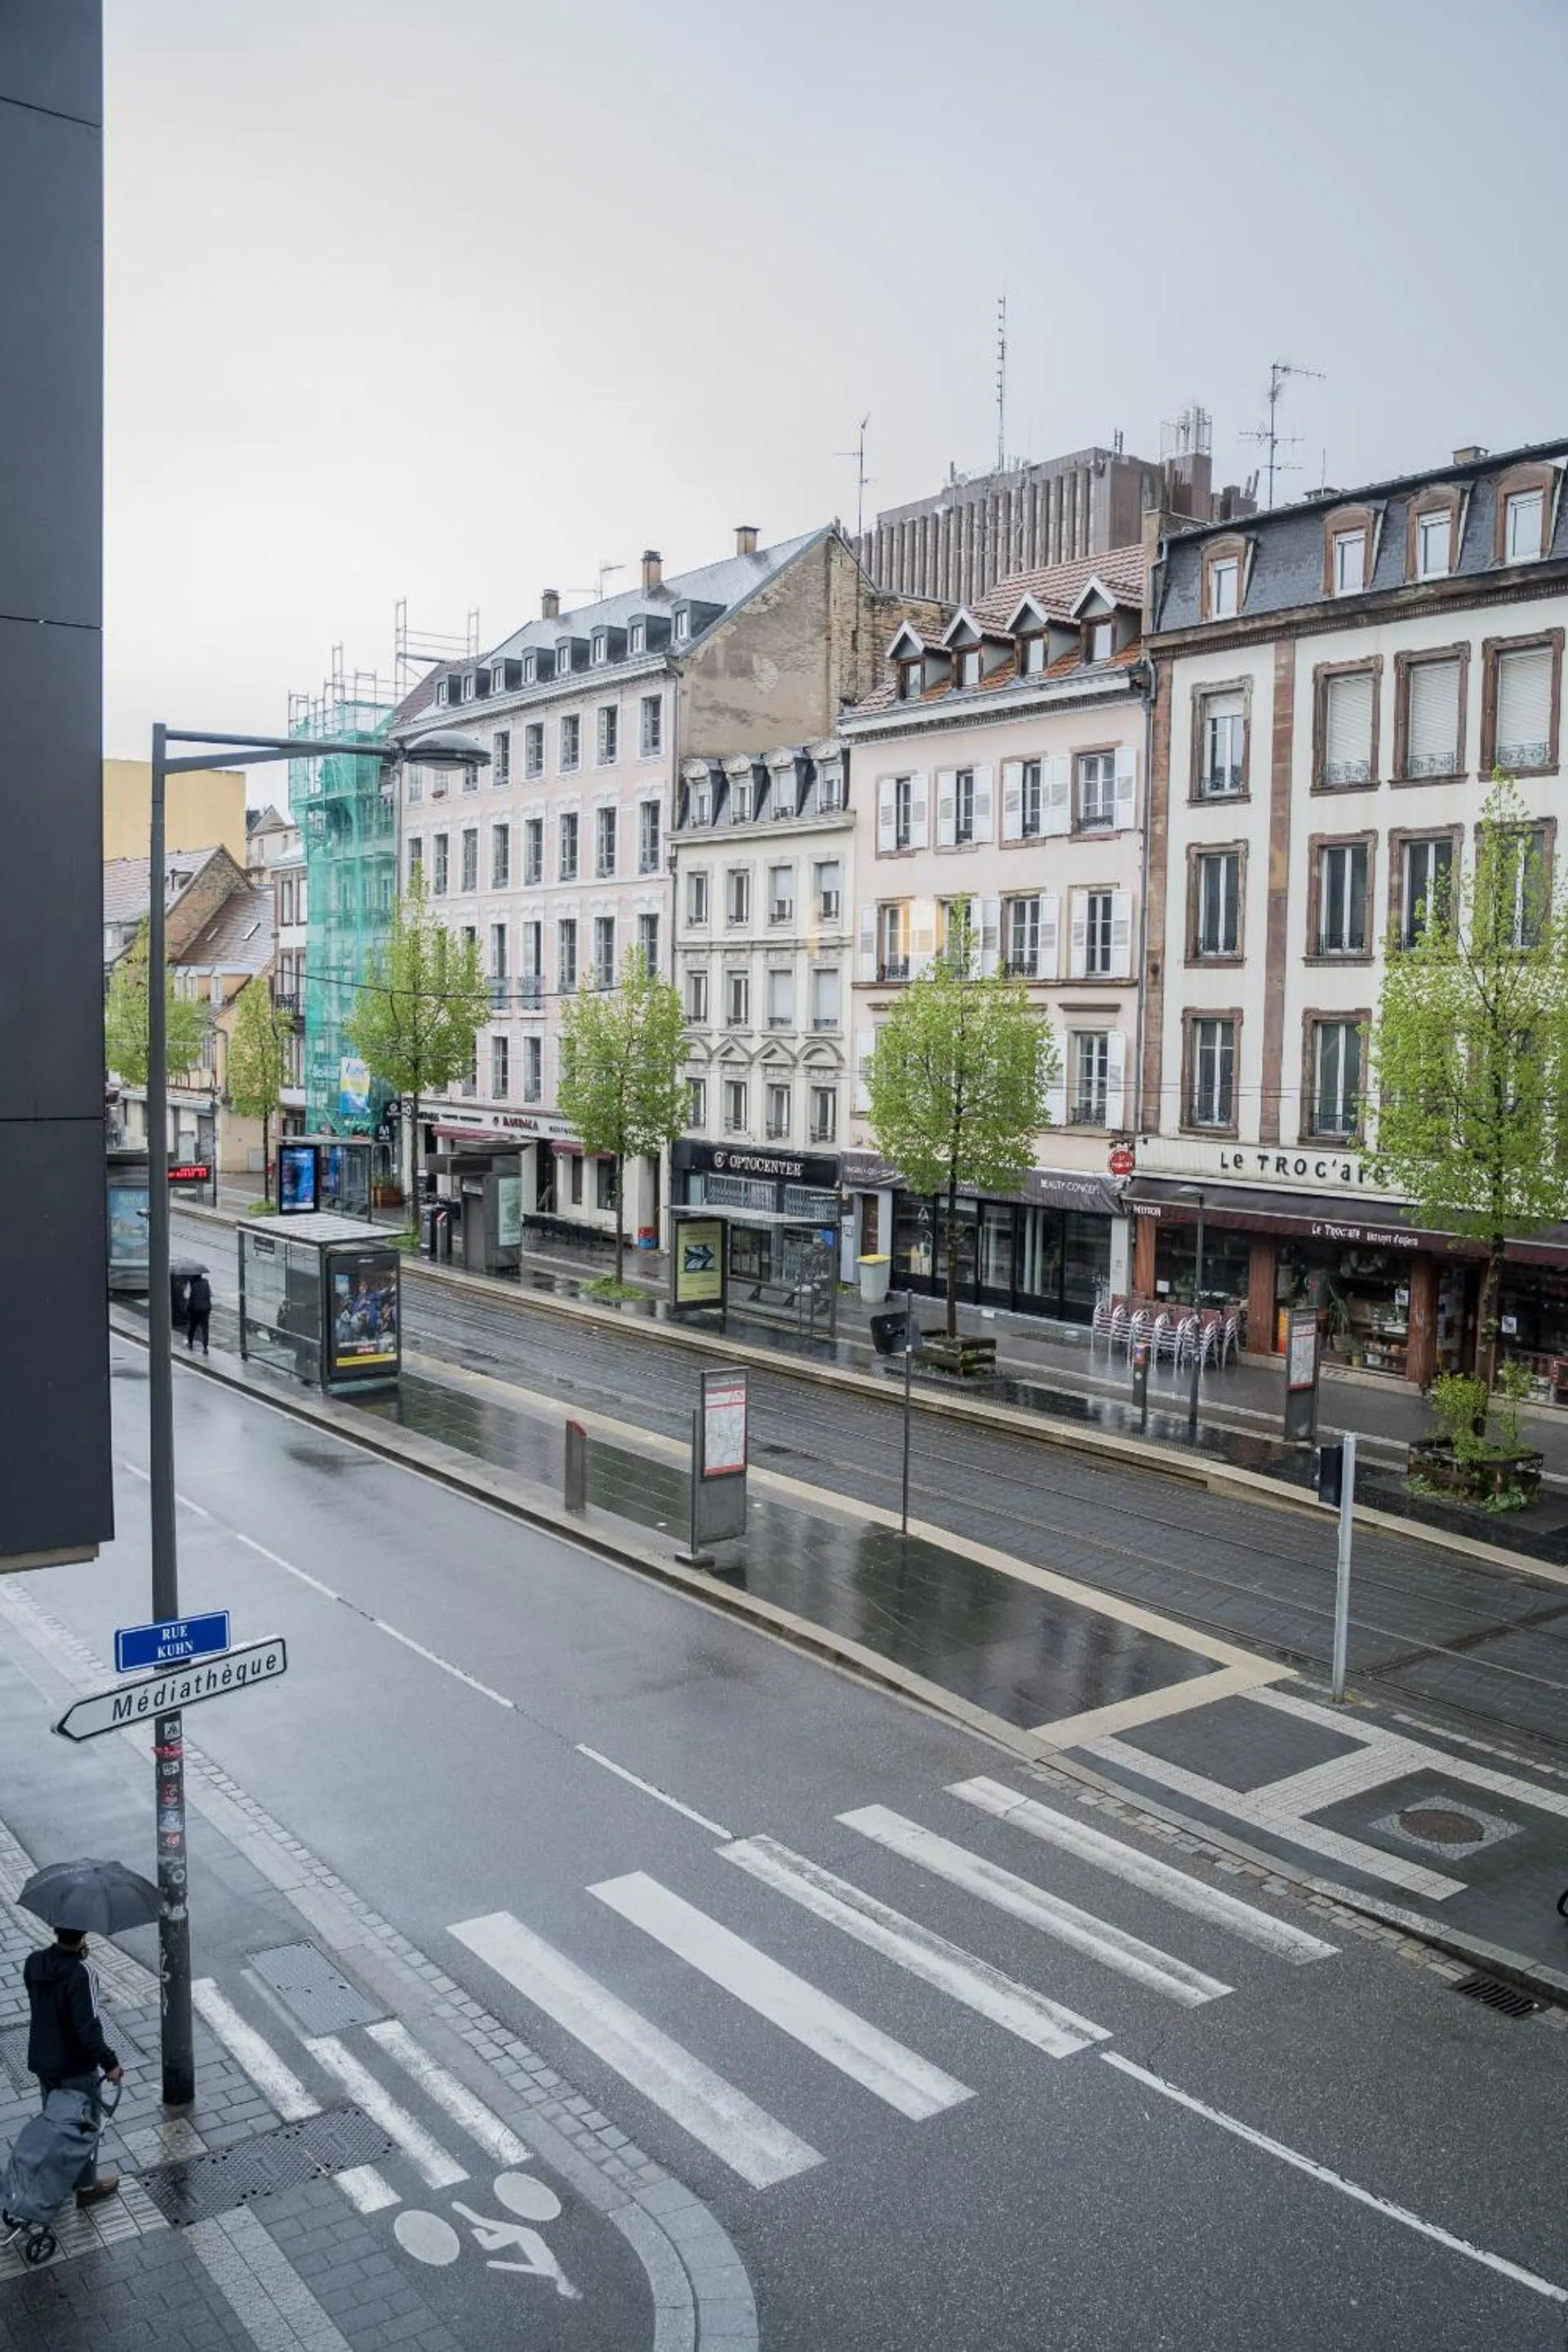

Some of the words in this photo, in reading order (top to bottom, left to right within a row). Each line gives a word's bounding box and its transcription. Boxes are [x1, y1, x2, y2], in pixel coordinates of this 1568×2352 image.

[730, 1155, 802, 1176] OPTOCENTER
[1220, 1152, 1243, 1168] Le
[1040, 1178, 1065, 1190] BEAUTY
[1066, 1181, 1100, 1195] CONCEPT
[162, 1625, 188, 1640] RUE
[158, 1641, 193, 1659] KUHN
[112, 1652, 278, 1721] Médiathèque
